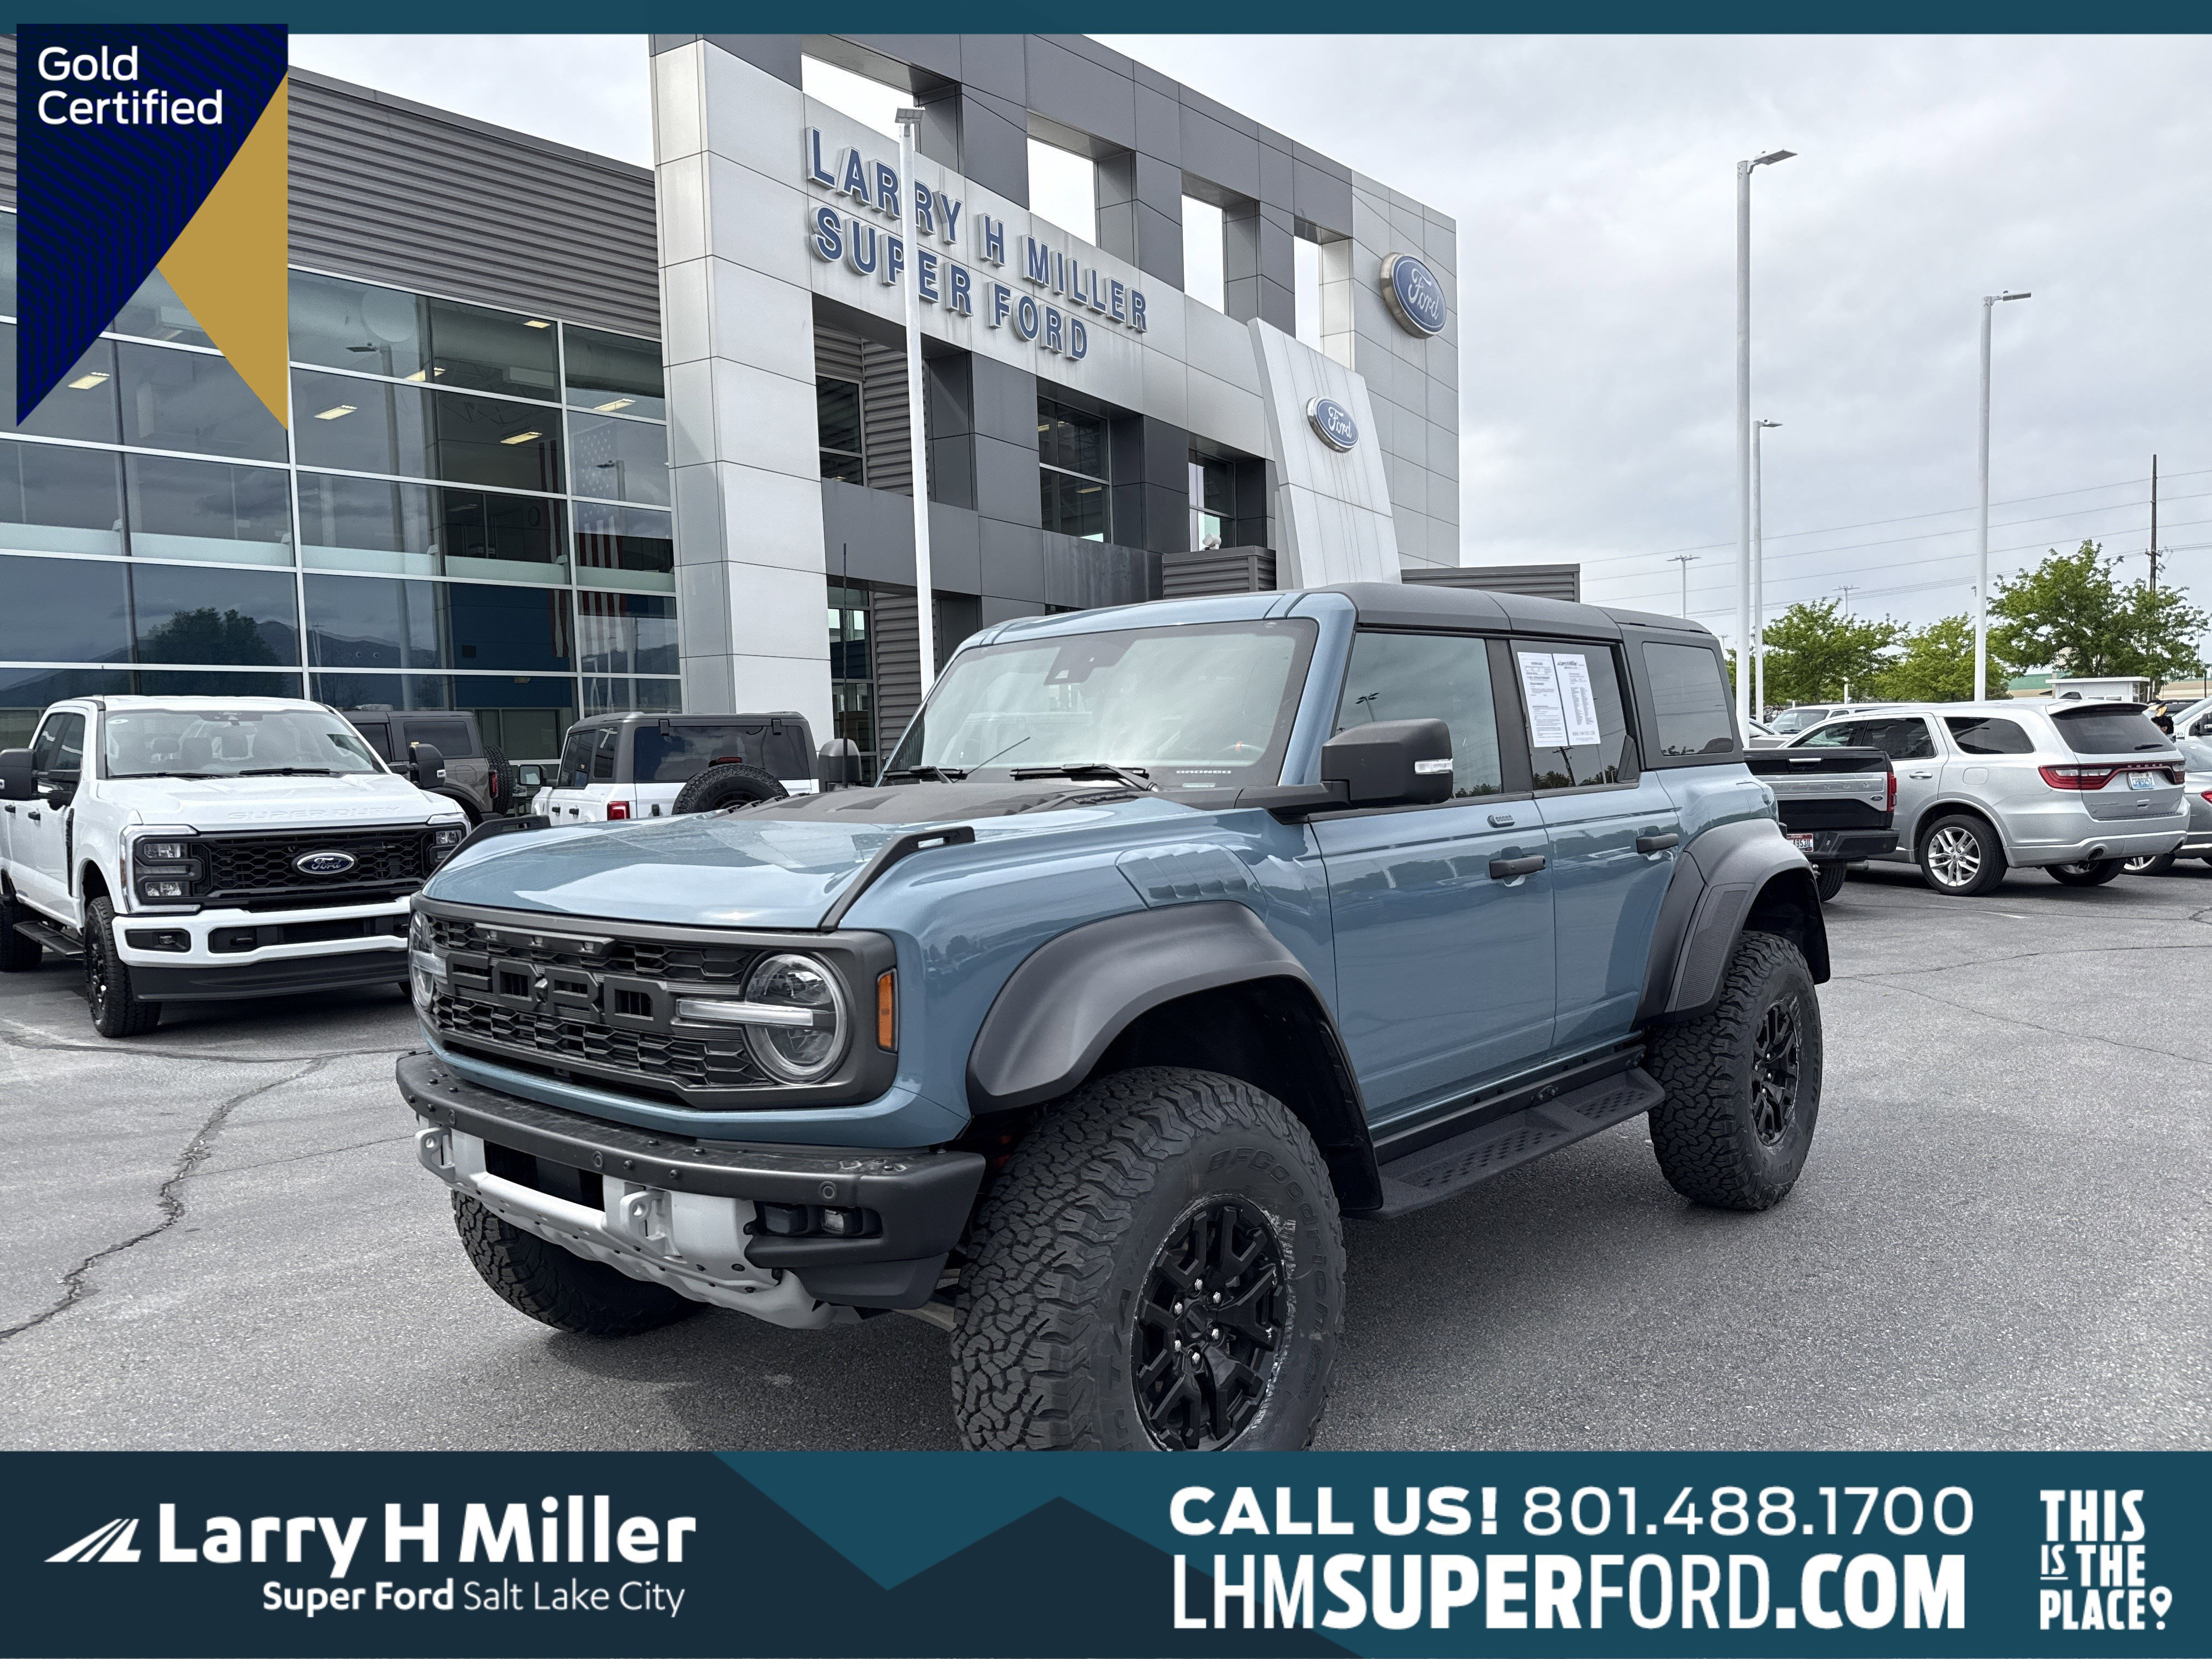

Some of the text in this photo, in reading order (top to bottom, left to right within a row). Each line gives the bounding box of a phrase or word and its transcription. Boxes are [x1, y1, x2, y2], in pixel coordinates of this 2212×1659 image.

[806, 126, 1148, 333] LARRY H MILLER
[811, 206, 1088, 361] SUPER FORD
[1408, 268, 1439, 321] Ford
[1327, 406, 1353, 439] Ford
[228, 806, 400, 820] SUPER DUTY
[311, 857, 343, 871] Ford
[446, 953, 674, 1034] FORD
[1207, 1146, 1329, 1332] BFGoodrich
